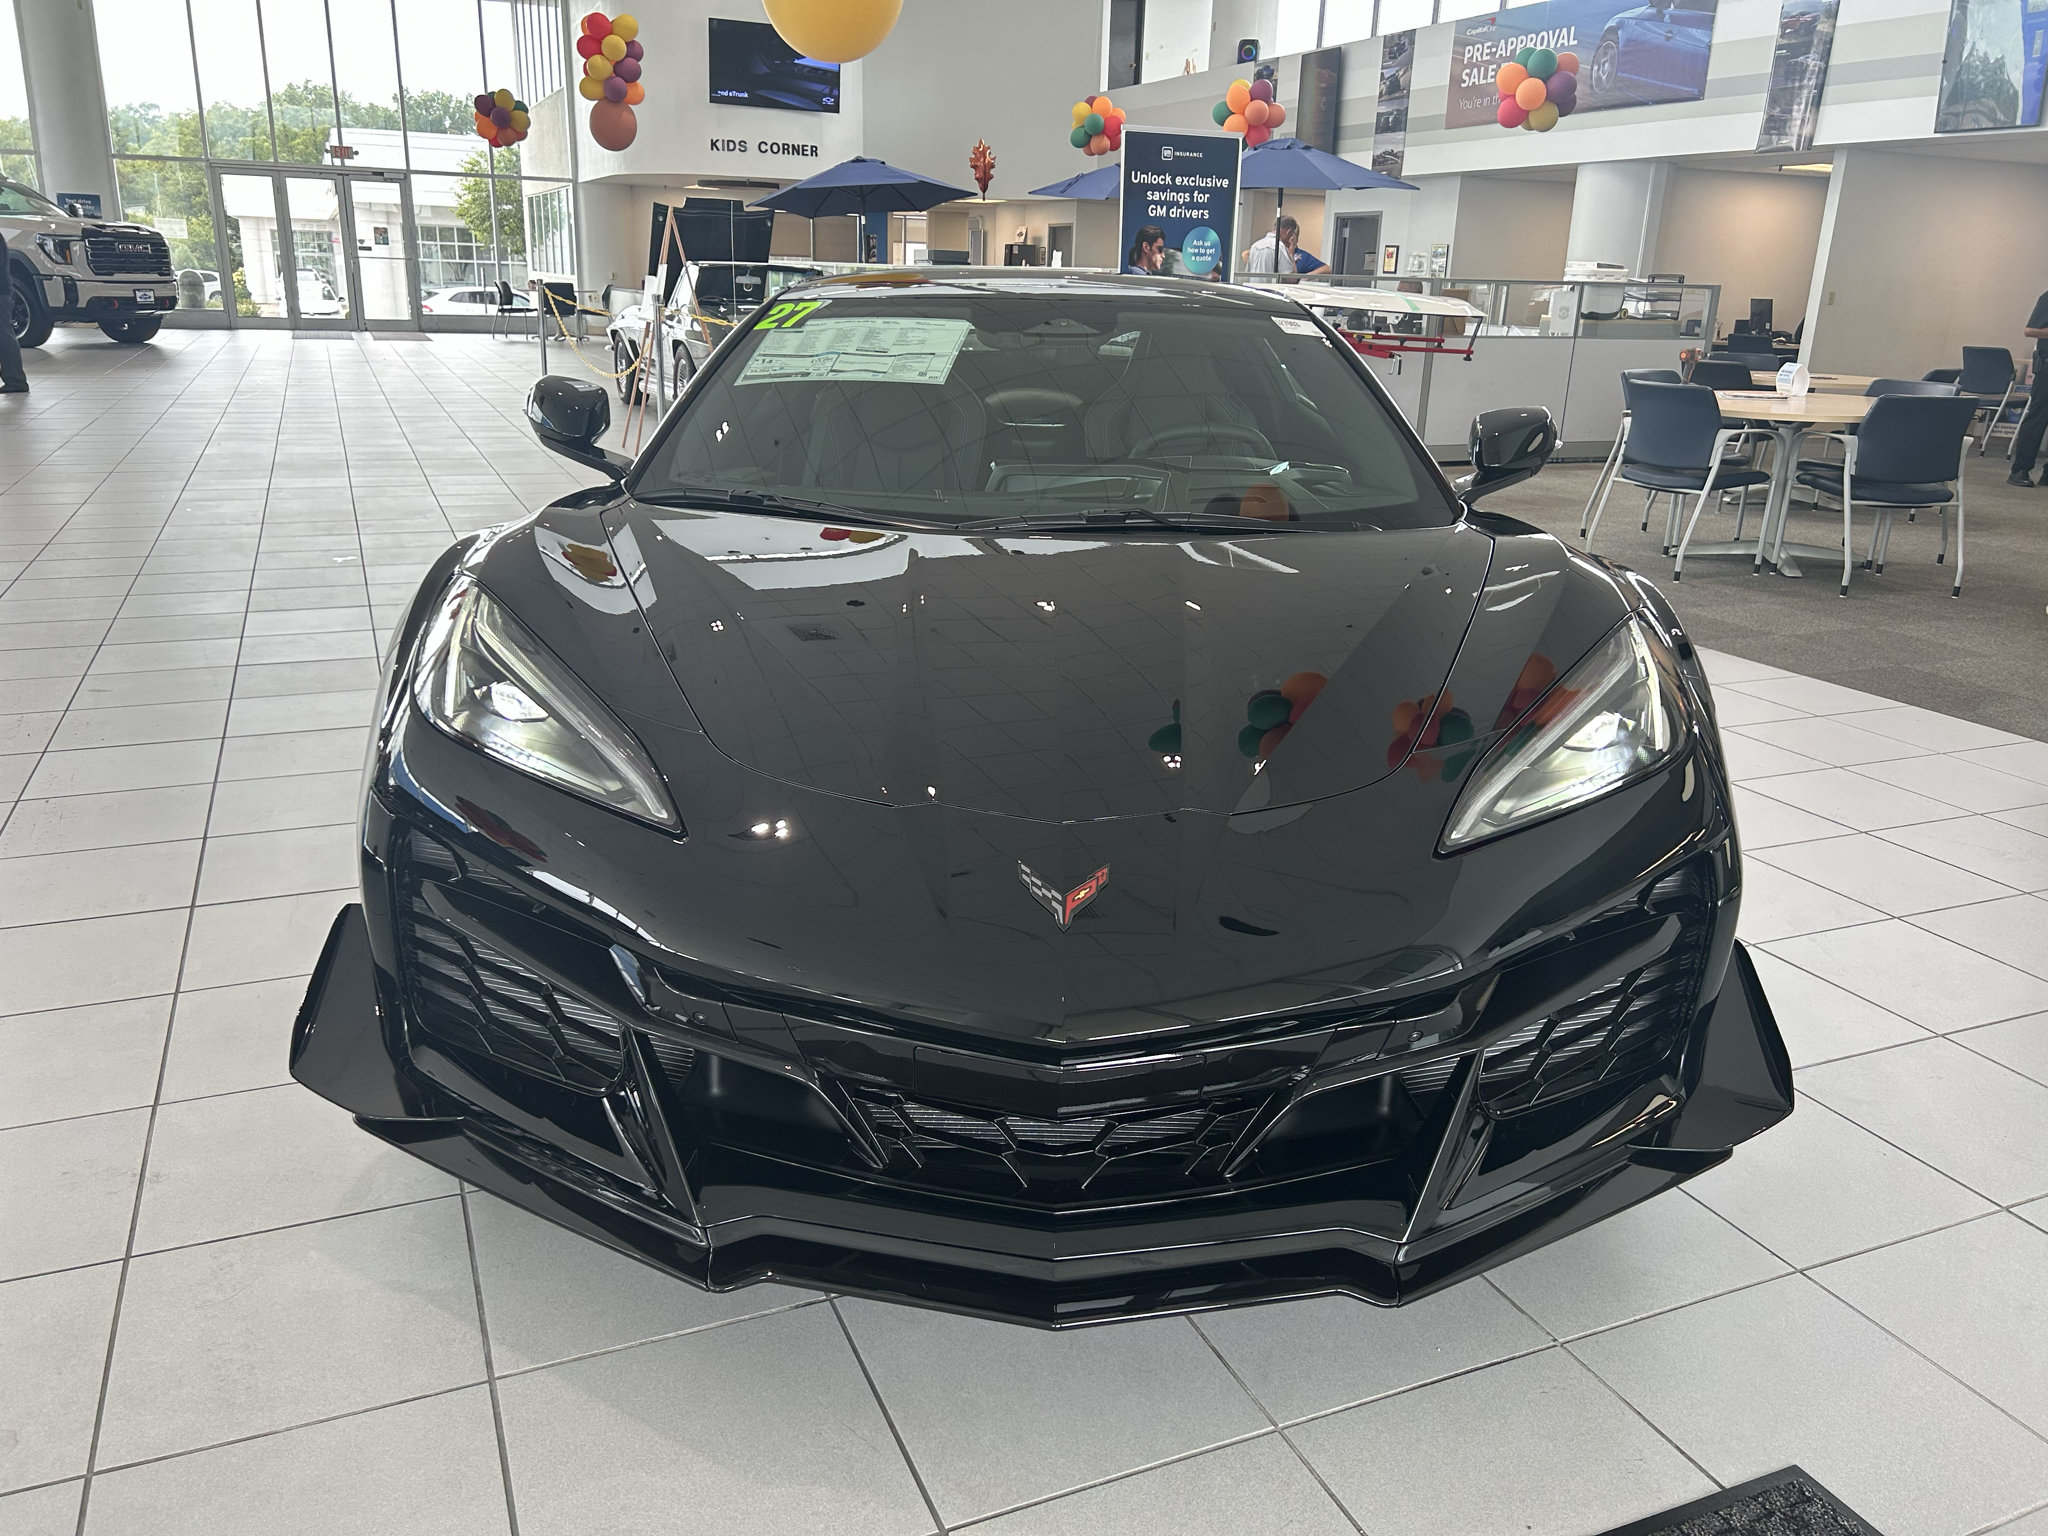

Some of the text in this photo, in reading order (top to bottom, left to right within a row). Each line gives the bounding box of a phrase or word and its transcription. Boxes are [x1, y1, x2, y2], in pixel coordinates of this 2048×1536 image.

[1463, 25, 1578, 64] PRE-APPROVAL
[1461, 64, 1496, 88] SALE
[1459, 96, 1481, 110] You're
[1483, 96, 1491, 106] in
[334, 146, 350, 158] EXIT
[710, 138, 818, 157] KIDS CORNER
[1174, 150, 1204, 158] INSURANCE
[1131, 170, 1229, 188] Unlock exclusive
[1146, 189, 1210, 204] savings for
[1148, 204, 1210, 219] GM drivers
[118, 243, 151, 254] GMC
[753, 301, 823, 330] 27
